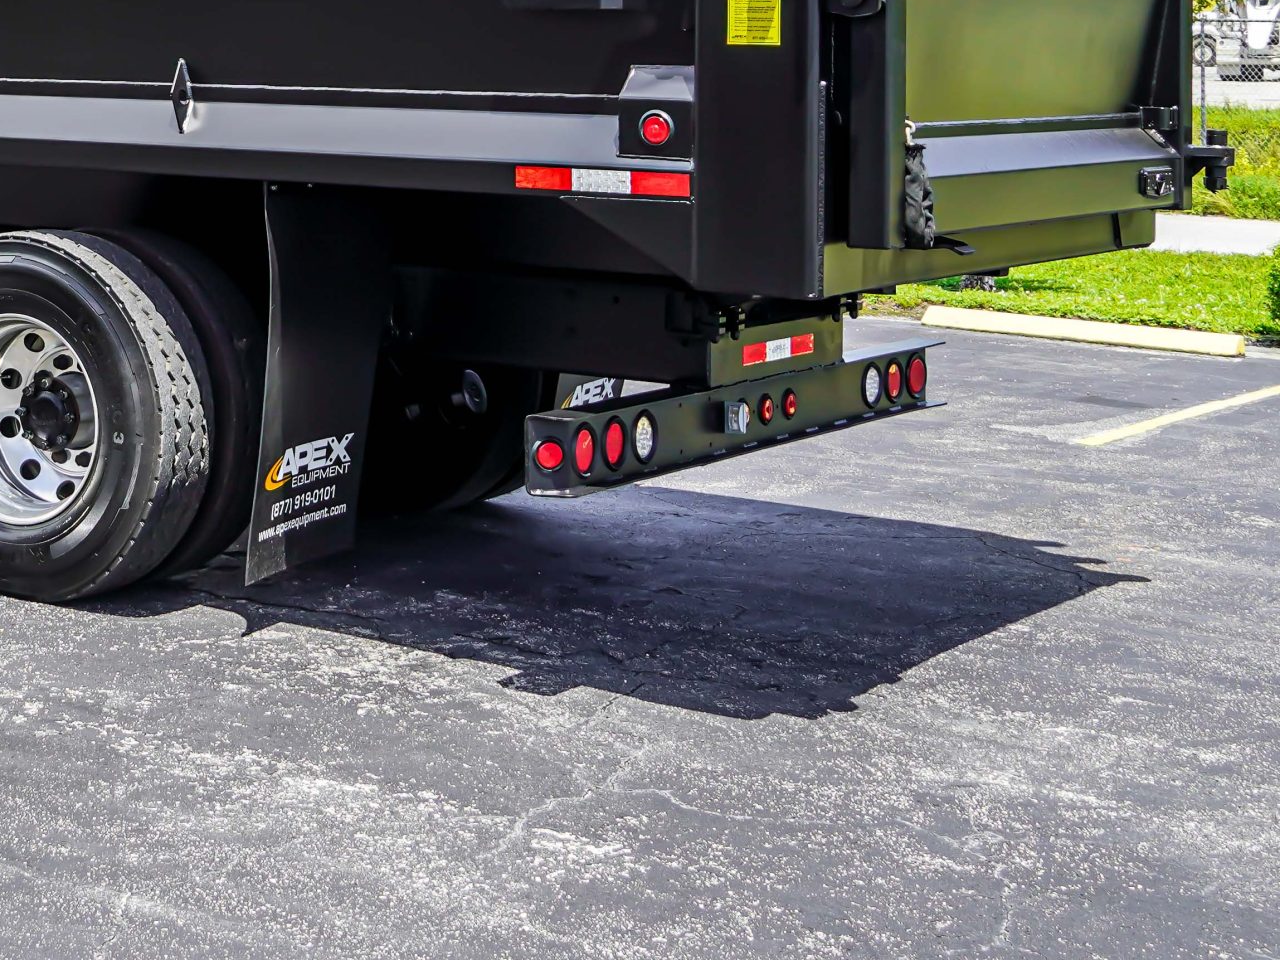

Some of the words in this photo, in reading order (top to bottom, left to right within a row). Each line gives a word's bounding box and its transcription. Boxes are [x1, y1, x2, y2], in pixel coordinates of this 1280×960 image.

[569, 377, 616, 408] APEX
[276, 432, 355, 482] APEX
[291, 462, 351, 488] EQUIPMENT
[270, 497, 293, 520] (877)
[294, 484, 336, 509] 919-0101
[258, 503, 347, 542] www.apexequipment.com
